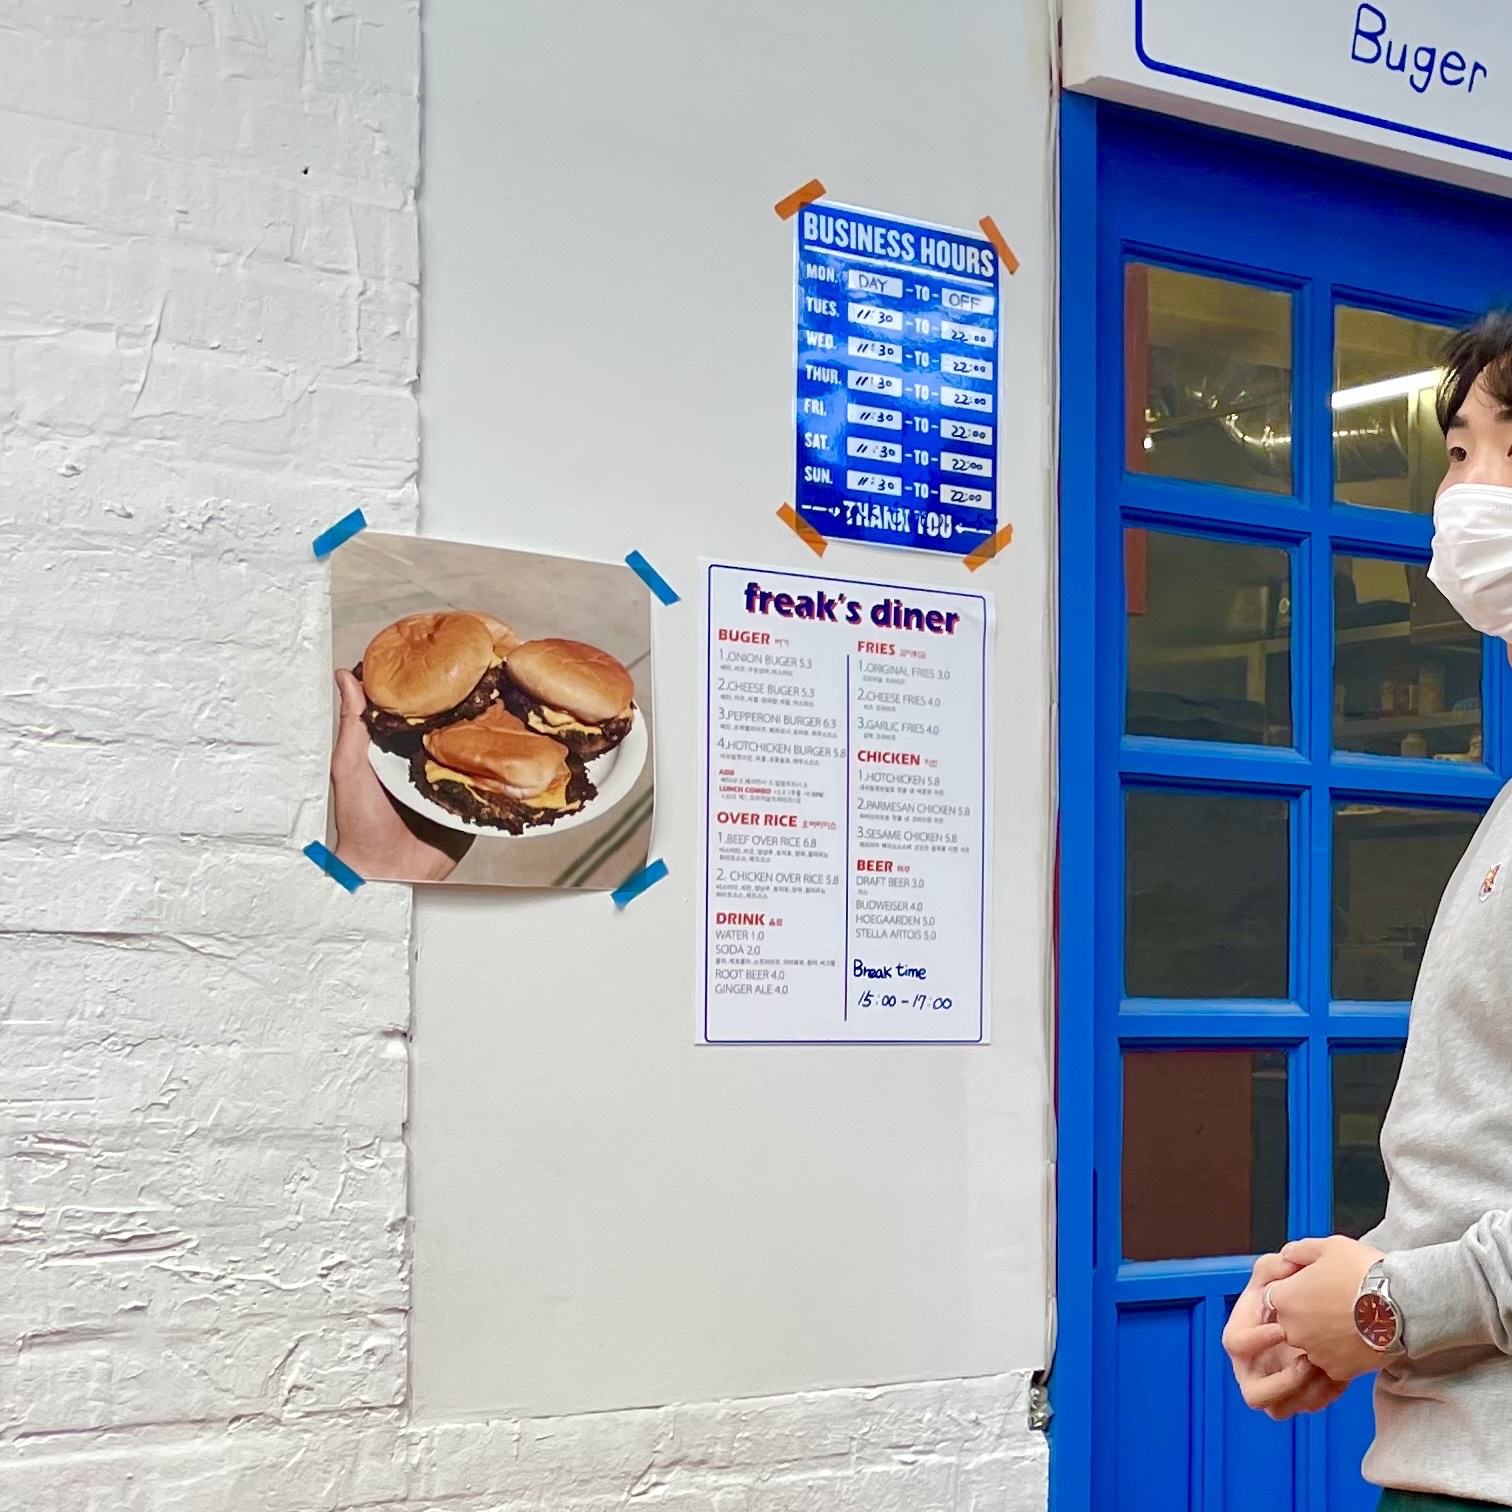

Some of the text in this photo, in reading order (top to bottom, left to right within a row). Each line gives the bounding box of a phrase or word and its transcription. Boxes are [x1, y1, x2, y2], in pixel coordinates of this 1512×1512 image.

[1351, 3, 1487, 93] Buger
[804, 211, 995, 278] BUSINESS HOURS
[806, 264, 838, 284] MON.
[858, 274, 888, 293] DAY
[806, 296, 840, 318] TUES.
[806, 330, 838, 350] WED.
[805, 365, 843, 385] THUR.
[804, 398, 827, 417] FRI.
[804, 432, 830, 451] SAT.
[804, 466, 833, 485] SUN.
[842, 500, 953, 539] THANK YOU
[744, 582, 960, 635] freak's diner
[718, 628, 771, 645] BUGER
[857, 640, 896, 656] FRIES
[911, 667, 935, 679] FRIES
[902, 694, 926, 707] FRIES
[783, 714, 820, 728] BURGER
[901, 722, 925, 735] FRIES
[793, 744, 831, 758] BURGER
[857, 749, 921, 766] CHICKEN
[916, 803, 956, 816] CHICKEN
[717, 811, 760, 826] OVER
[763, 813, 798, 828] RICE
[751, 834, 778, 846] OVER
[903, 830, 943, 842] CHICKEN
[856, 859, 893, 873] BEER
[729, 870, 773, 882] CHICKEN
[775, 872, 801, 884] OVER
[856, 875, 887, 887] DRAFT
[888, 877, 910, 888] BEER
[855, 899, 908, 911] BUDWEISER
[715, 911, 766, 926] DRINK
[855, 914, 921, 926] HOEGAARDEN
[715, 929, 749, 941] WATER
[855, 928, 888, 939] STELLA
[715, 944, 745, 955] SODA
[715, 968, 744, 980] ROOT
[745, 969, 769, 980] BEER
[896, 961, 927, 981] time
[714, 983, 753, 995] GINGER
[754, 984, 773, 995] ALE
